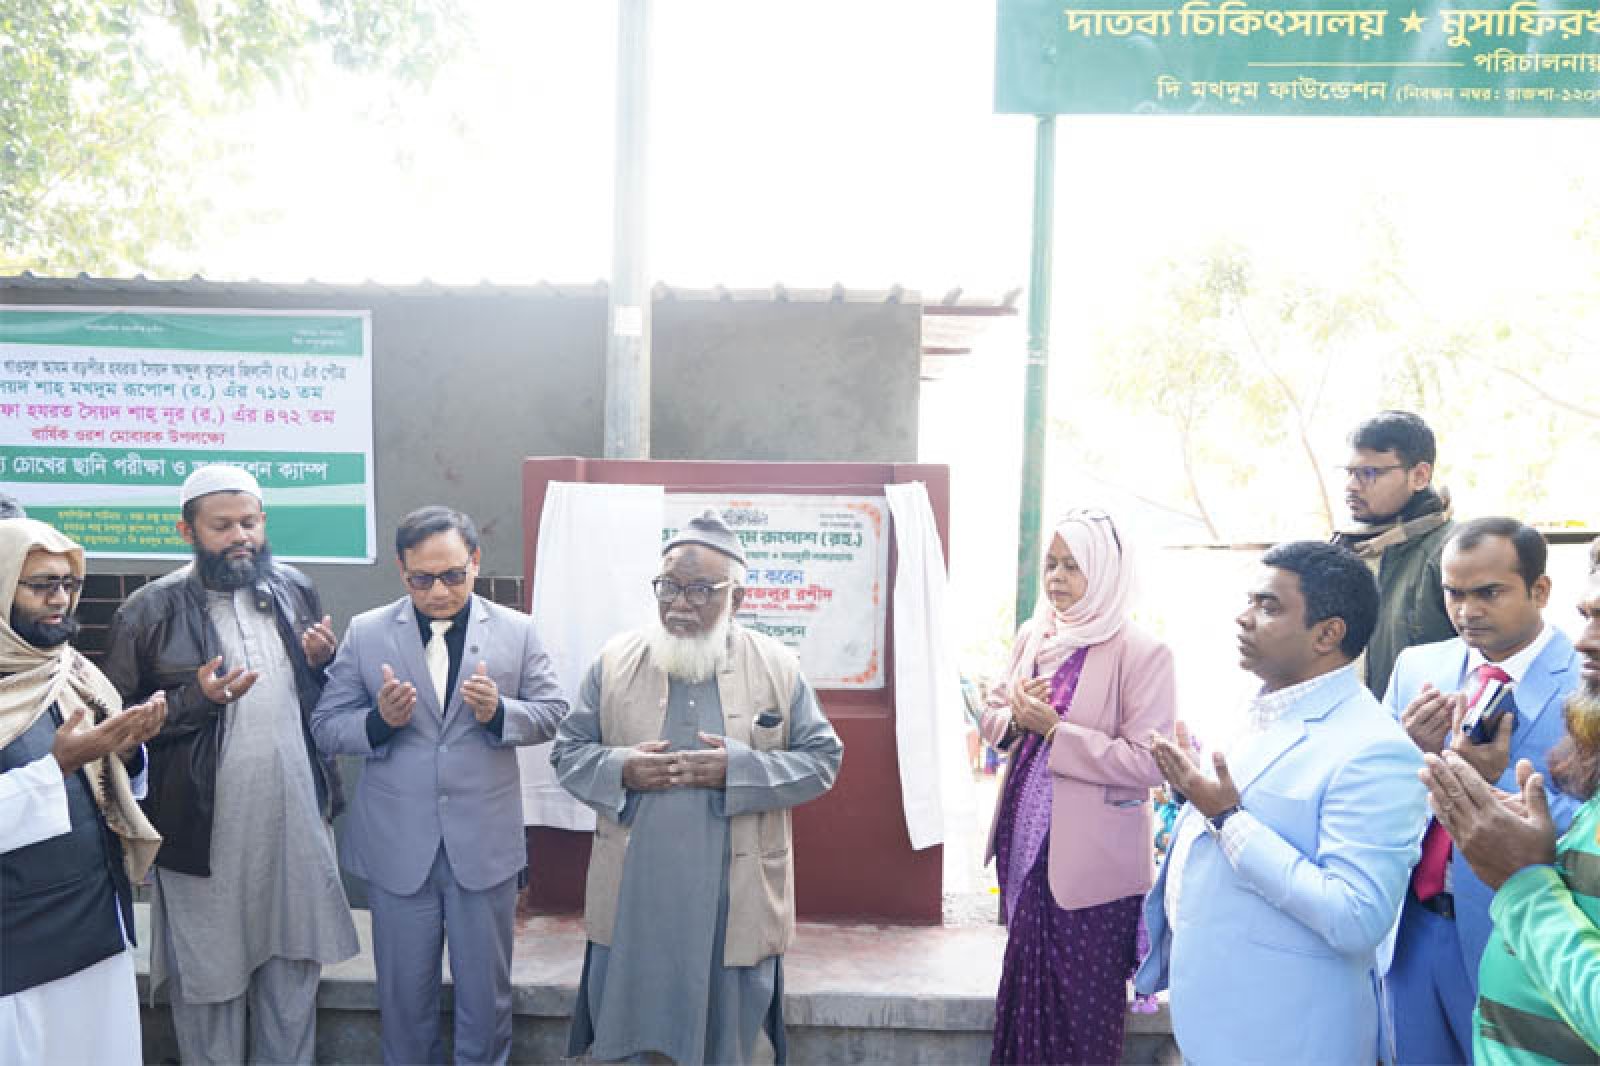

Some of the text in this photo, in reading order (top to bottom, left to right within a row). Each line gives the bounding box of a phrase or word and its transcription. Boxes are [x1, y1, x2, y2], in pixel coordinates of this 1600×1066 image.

[1064, 9, 1174, 37] দাতব্য
[1178, 1, 1389, 41] চিকিৎসালয়
[1156, 73, 1183, 99] দি
[1190, 80, 1260, 104] মখদুম
[1267, 76, 1388, 101] ফাউন্ডেশন
[70, 381, 117, 399] মখদুম
[256, 385, 291, 401] ৭১৬
[295, 385, 323, 401] তম
[27, 403, 74, 420] হযরত
[78, 401, 123, 420] সৈয়দ
[263, 408, 303, 427] ৪৭২
[307, 408, 337, 425] তম
[31, 424, 69, 441] বার্ষিক
[110, 430, 163, 443] মোবারক
[12, 454, 67, 474] চোখের
[72, 451, 107, 478] ছানি
[112, 451, 165, 479] পরীক্ষা
[172, 460, 188, 476] ও
[276, 461, 329, 481] ক্যাম্প
